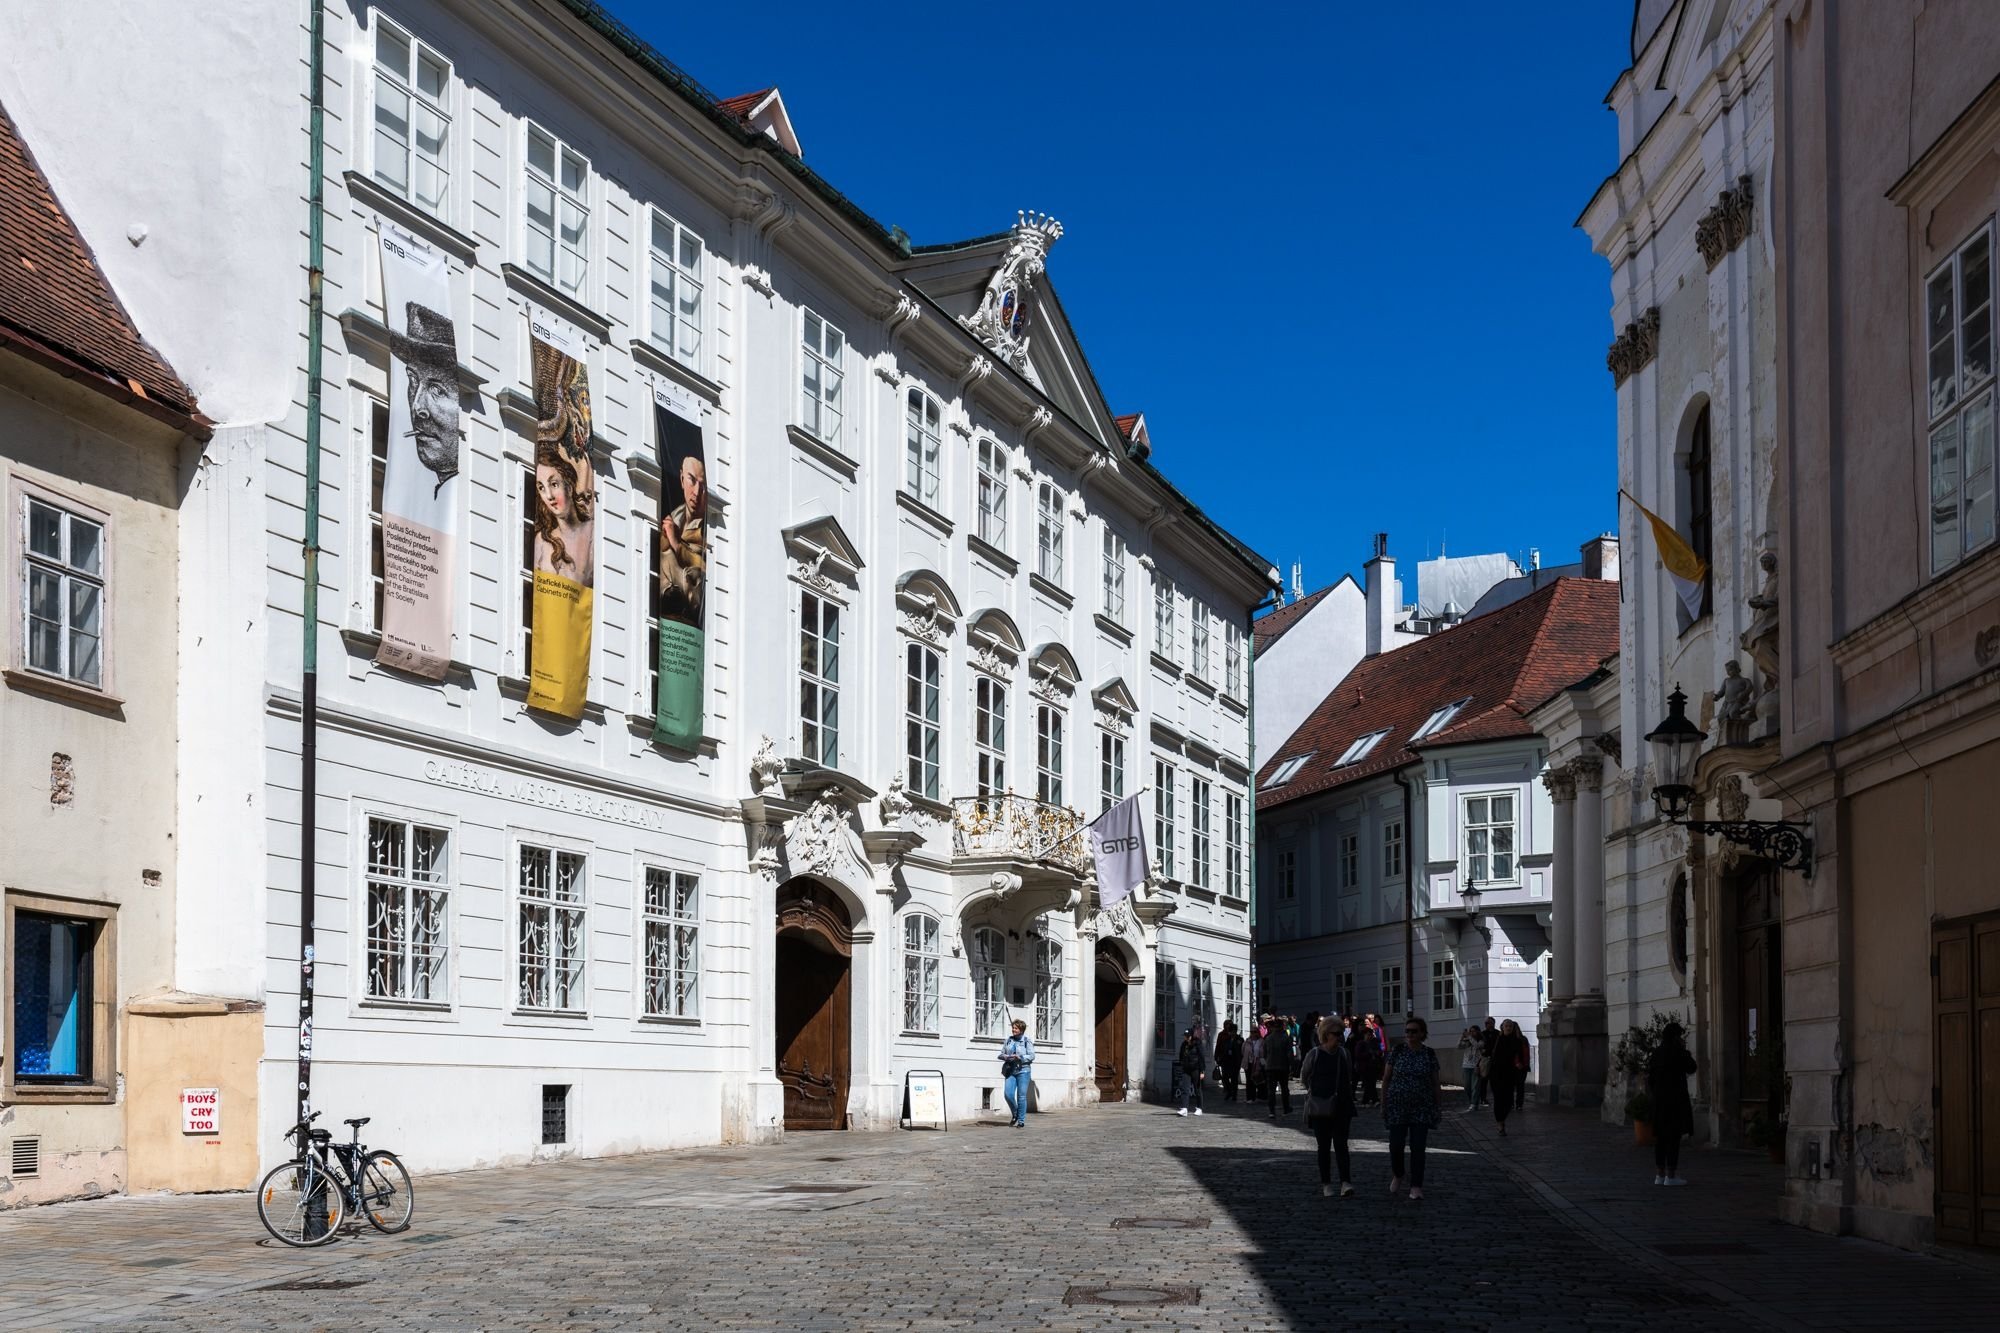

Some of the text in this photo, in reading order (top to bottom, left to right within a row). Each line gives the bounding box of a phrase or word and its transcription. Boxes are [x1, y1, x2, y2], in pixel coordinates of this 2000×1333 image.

[384, 238, 405, 259] GMB
[533, 322, 551, 340] GMB
[386, 521, 431, 543] Július Schubert
[386, 530, 439, 556] Posledný predseda
[402, 565, 428, 581] Schubert
[420, 562, 439, 575] spolku
[386, 570, 425, 589] Last Chairman
[386, 589, 416, 606] Art Society
[392, 581, 402, 591] the
[403, 584, 429, 600] Bratislava
[536, 584, 562, 598] Cabinets
[423, 759, 666, 829] GALÉRIA MESTA BRATISLAVY
[1101, 836, 1140, 854] GMB
[187, 1095, 216, 1104] BOYS
[191, 1108, 213, 1117] CRY
[189, 1121, 213, 1130] TOO
